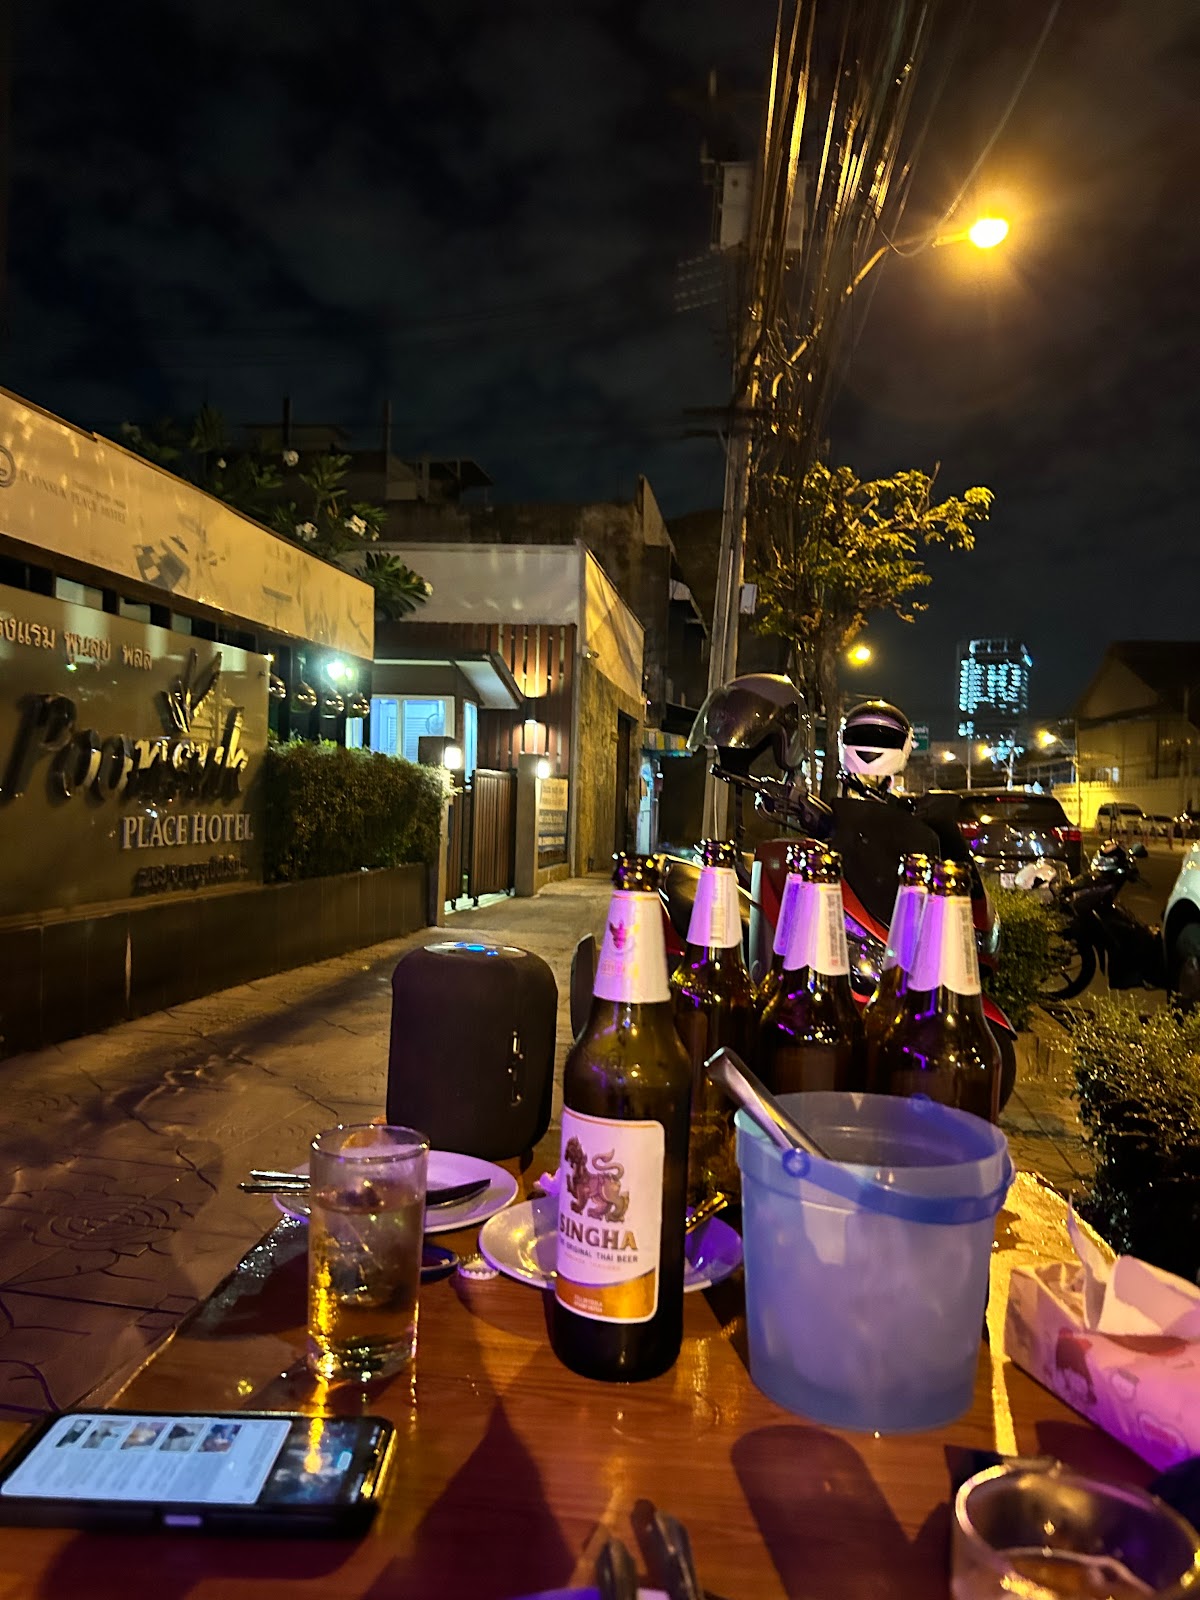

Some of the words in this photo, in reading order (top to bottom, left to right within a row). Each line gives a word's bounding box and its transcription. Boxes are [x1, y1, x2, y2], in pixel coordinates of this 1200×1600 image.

[122, 814, 189, 850] PLACE
[192, 812, 254, 845] HOTEL
[560, 1213, 638, 1251] SINGHA
[567, 1242, 592, 1258] ORIGINAL
[596, 1252, 613, 1262] THAI
[616, 1254, 638, 1263] BEER
